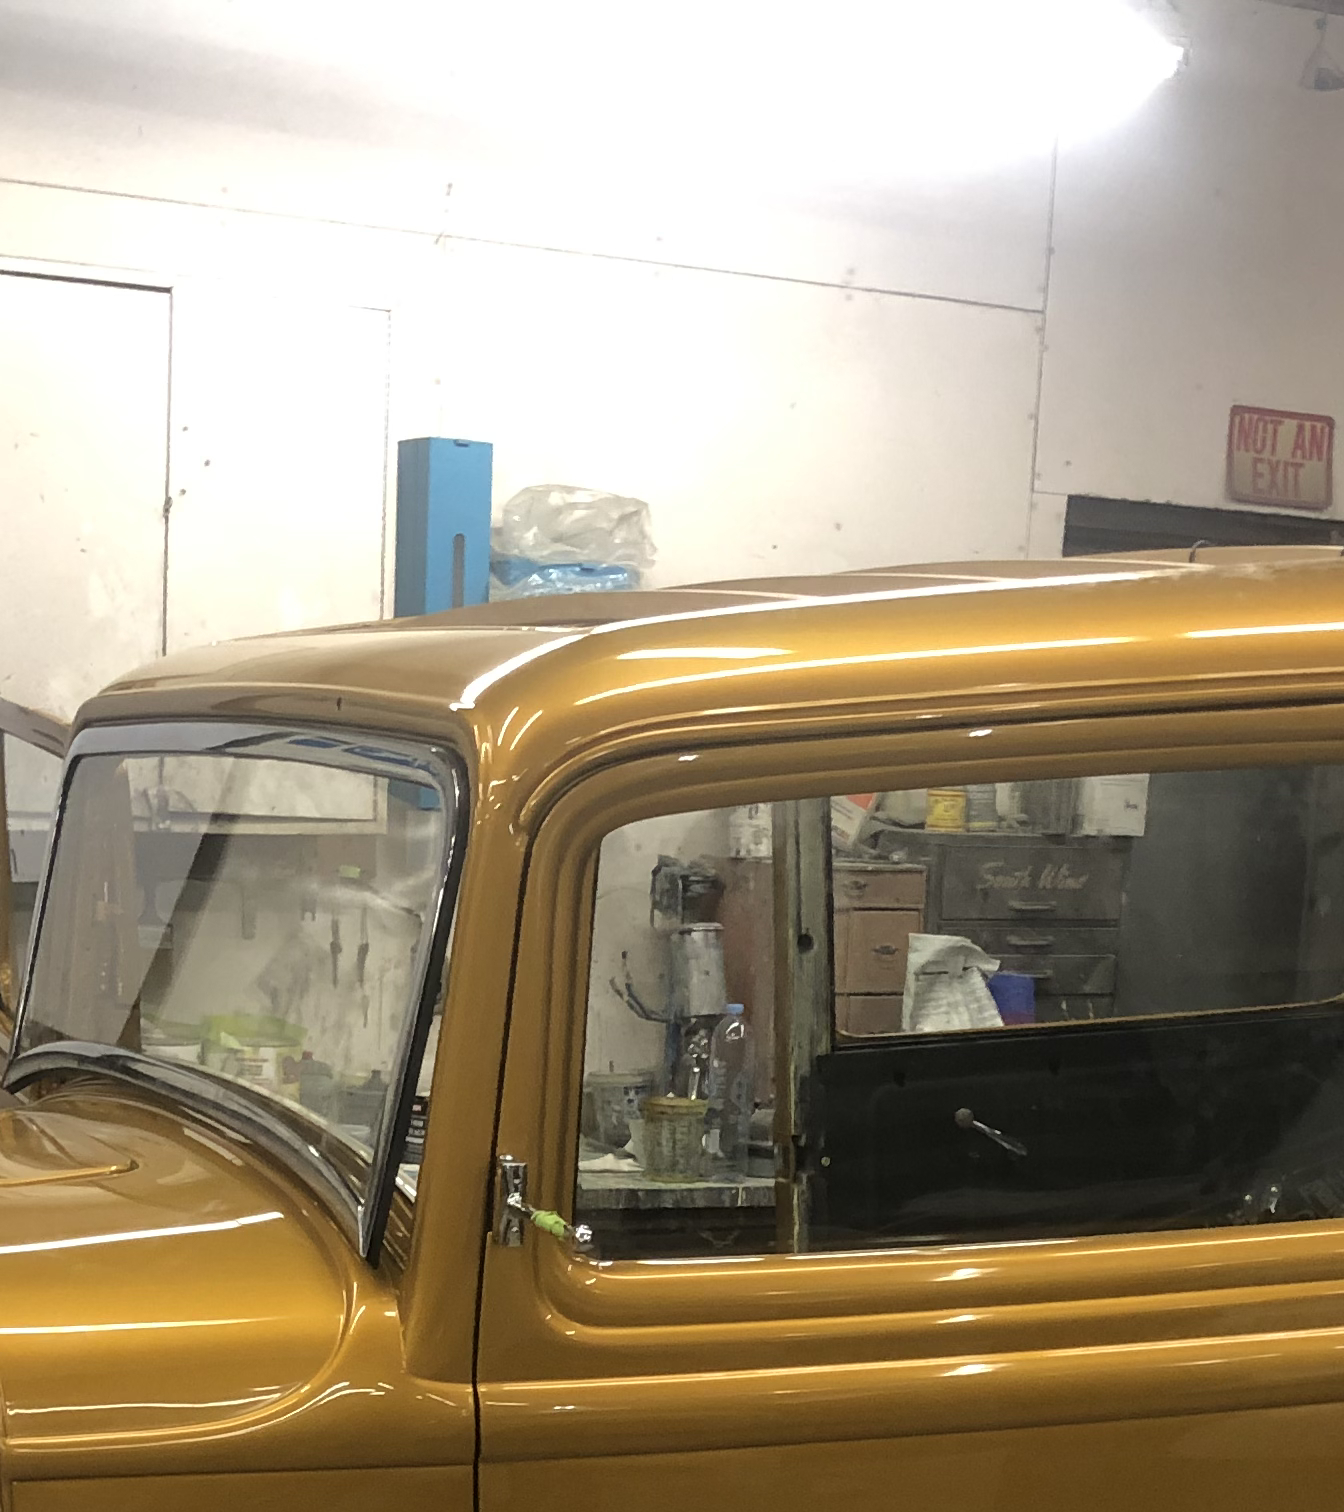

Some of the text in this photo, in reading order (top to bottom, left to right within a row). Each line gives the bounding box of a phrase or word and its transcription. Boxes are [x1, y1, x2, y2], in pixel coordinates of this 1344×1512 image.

[1235, 413, 1327, 462] NOT AN
[1251, 457, 1305, 499] EXIT
